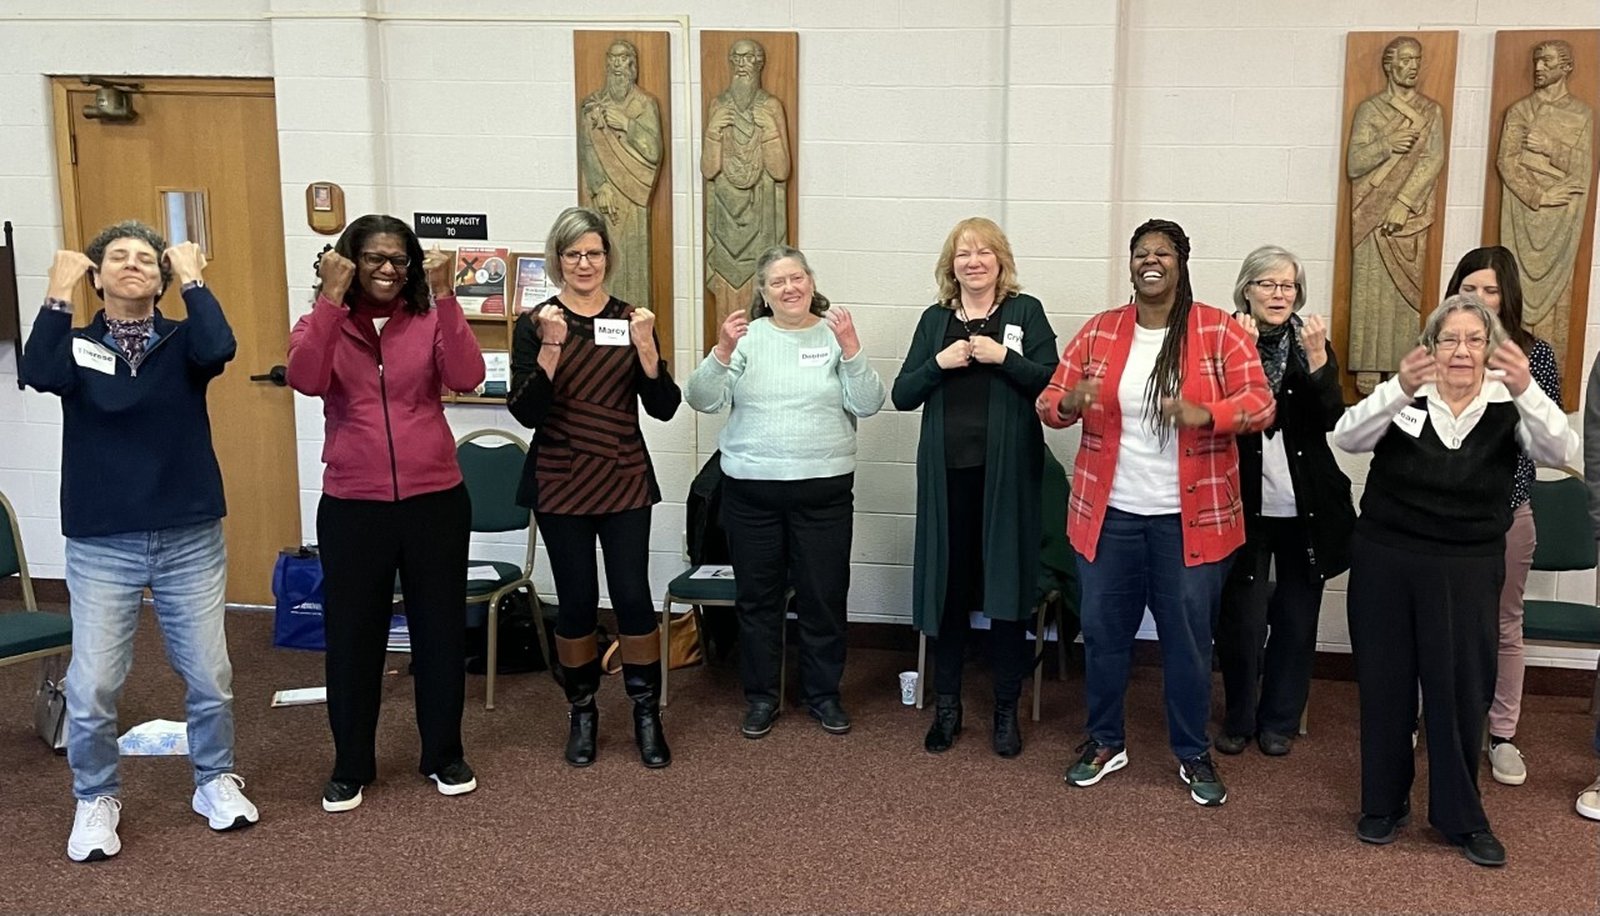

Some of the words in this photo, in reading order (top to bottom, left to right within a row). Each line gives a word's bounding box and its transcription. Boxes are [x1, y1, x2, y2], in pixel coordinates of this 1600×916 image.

[420, 216, 442, 225] ROOM
[445, 216, 480, 226] CAPACITY
[446, 227, 456, 236] 70
[598, 326, 626, 337] Marcy
[78, 347, 114, 362] Therese
